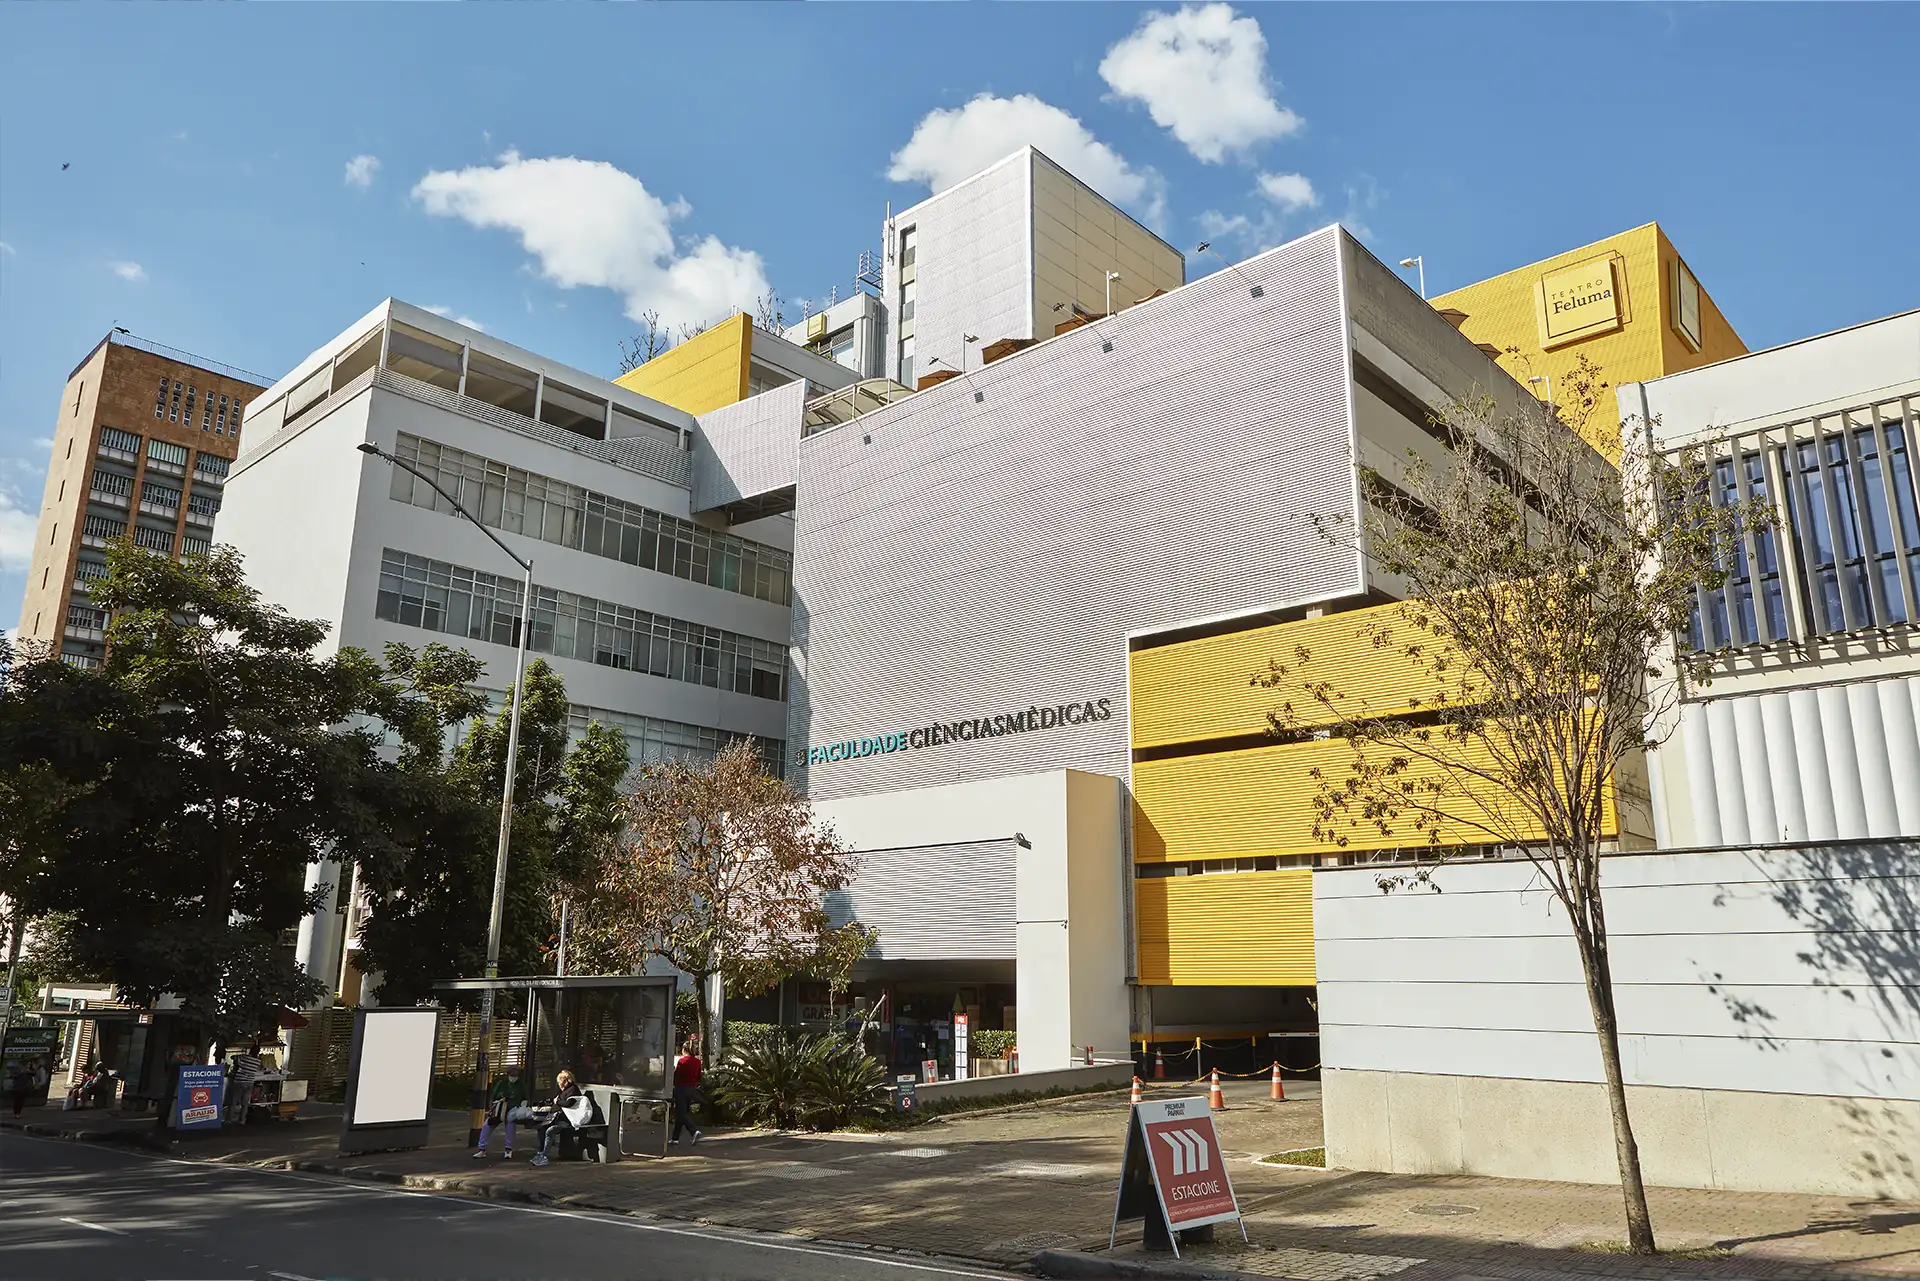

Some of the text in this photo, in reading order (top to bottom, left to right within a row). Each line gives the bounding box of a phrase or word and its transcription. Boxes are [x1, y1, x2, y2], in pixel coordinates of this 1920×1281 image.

[1551, 279, 1603, 300] TEATRO
[1553, 289, 1612, 315] Feluma
[808, 732, 907, 765] FACULDADE
[803, 1004, 840, 1020] GRÁTS
[183, 1070, 221, 1078] ESTACIONE
[185, 1109, 215, 1118] ARAUJO
[1164, 1102, 1186, 1110] PREMIUM
[1171, 1180, 1221, 1201] ESTACIONE
